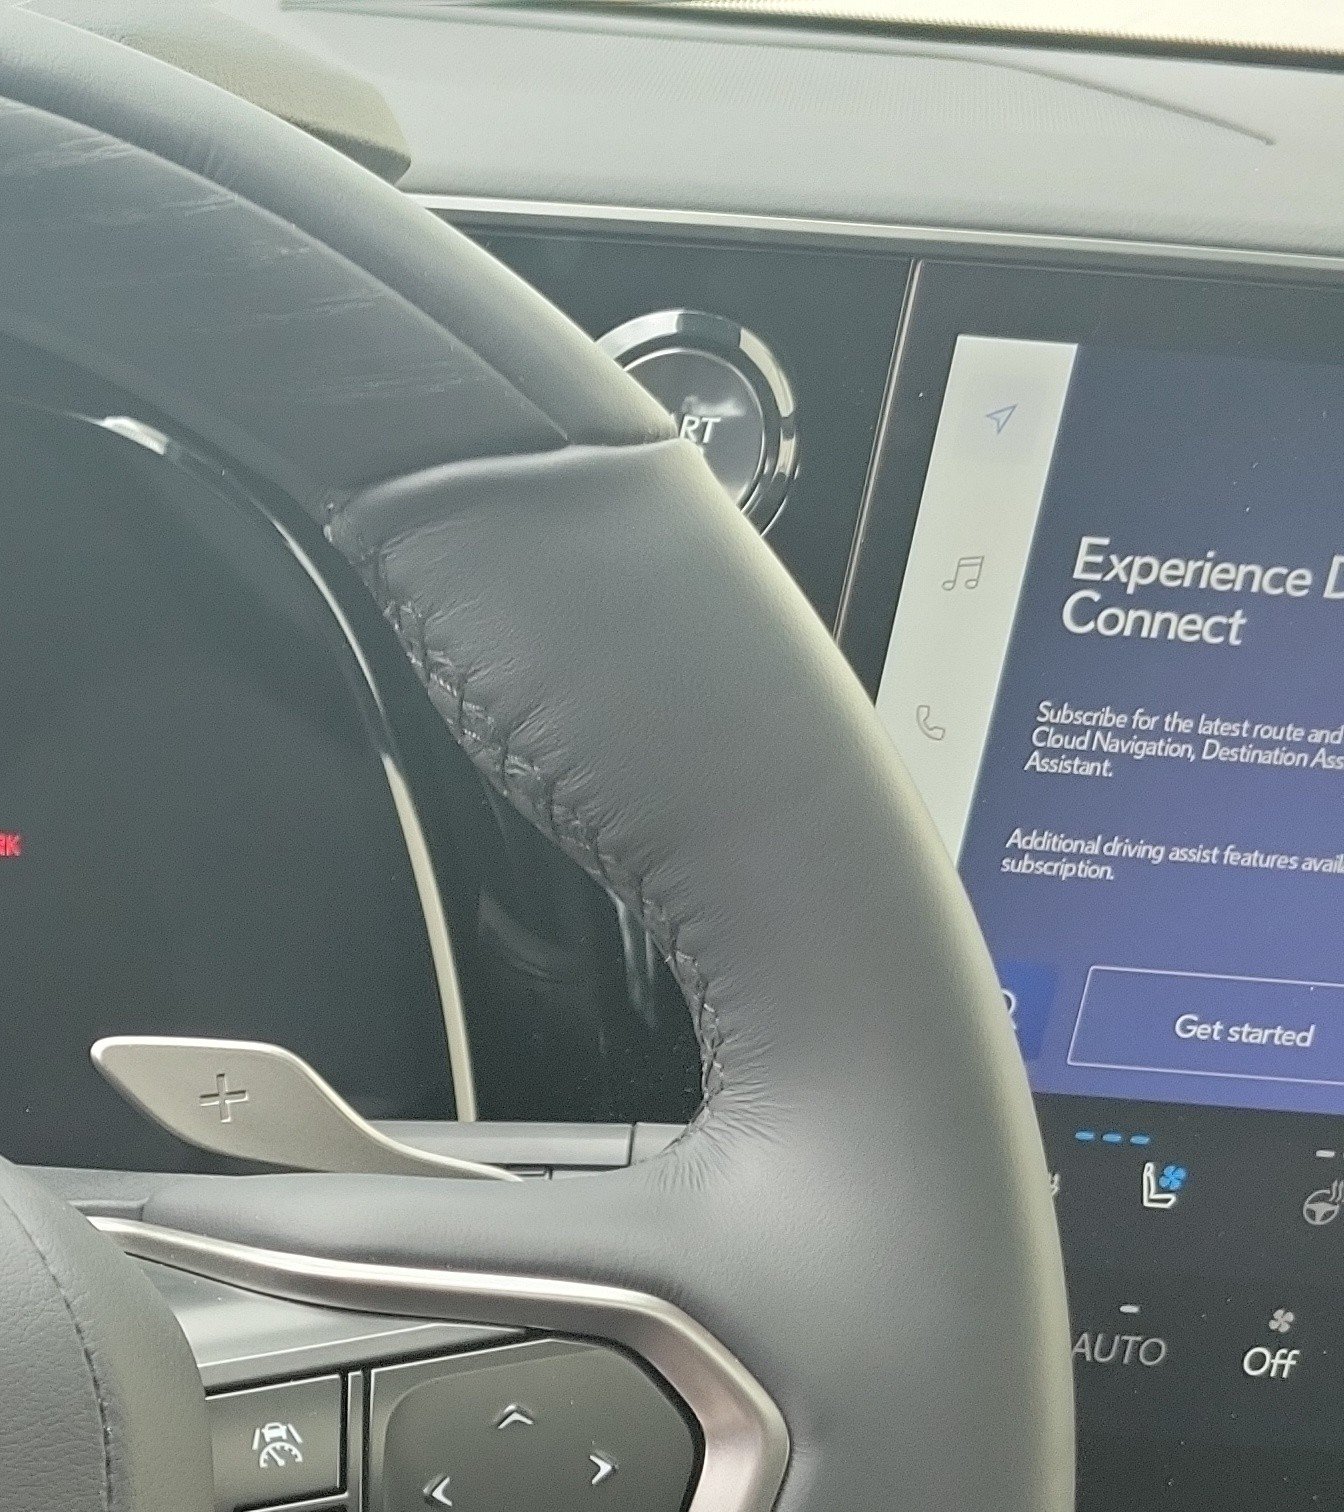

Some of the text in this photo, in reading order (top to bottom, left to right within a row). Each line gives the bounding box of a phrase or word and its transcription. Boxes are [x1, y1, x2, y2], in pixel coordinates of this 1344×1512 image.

[1073, 536, 1312, 597] Experience
[1062, 589, 1248, 646] Connect
[1036, 700, 1127, 729] Subscribe
[1131, 709, 1160, 731] for
[1163, 711, 1193, 733] the
[1197, 714, 1249, 738] latest
[1252, 722, 1304, 742] route
[1023, 750, 1114, 778] Assistant.
[1031, 725, 1092, 751] Cloud
[1092, 731, 1196, 762] Navigation,
[1201, 739, 1307, 768] Destination
[1000, 855, 1116, 880] subscription.
[1005, 827, 1102, 856] Additional
[1103, 834, 1165, 864] driving
[1168, 843, 1220, 865] assist
[1222, 845, 1299, 870] features
[1174, 1013, 1316, 1047] Get started
[1071, 1333, 1166, 1367] AUTO
[1243, 1346, 1301, 1379] Off
